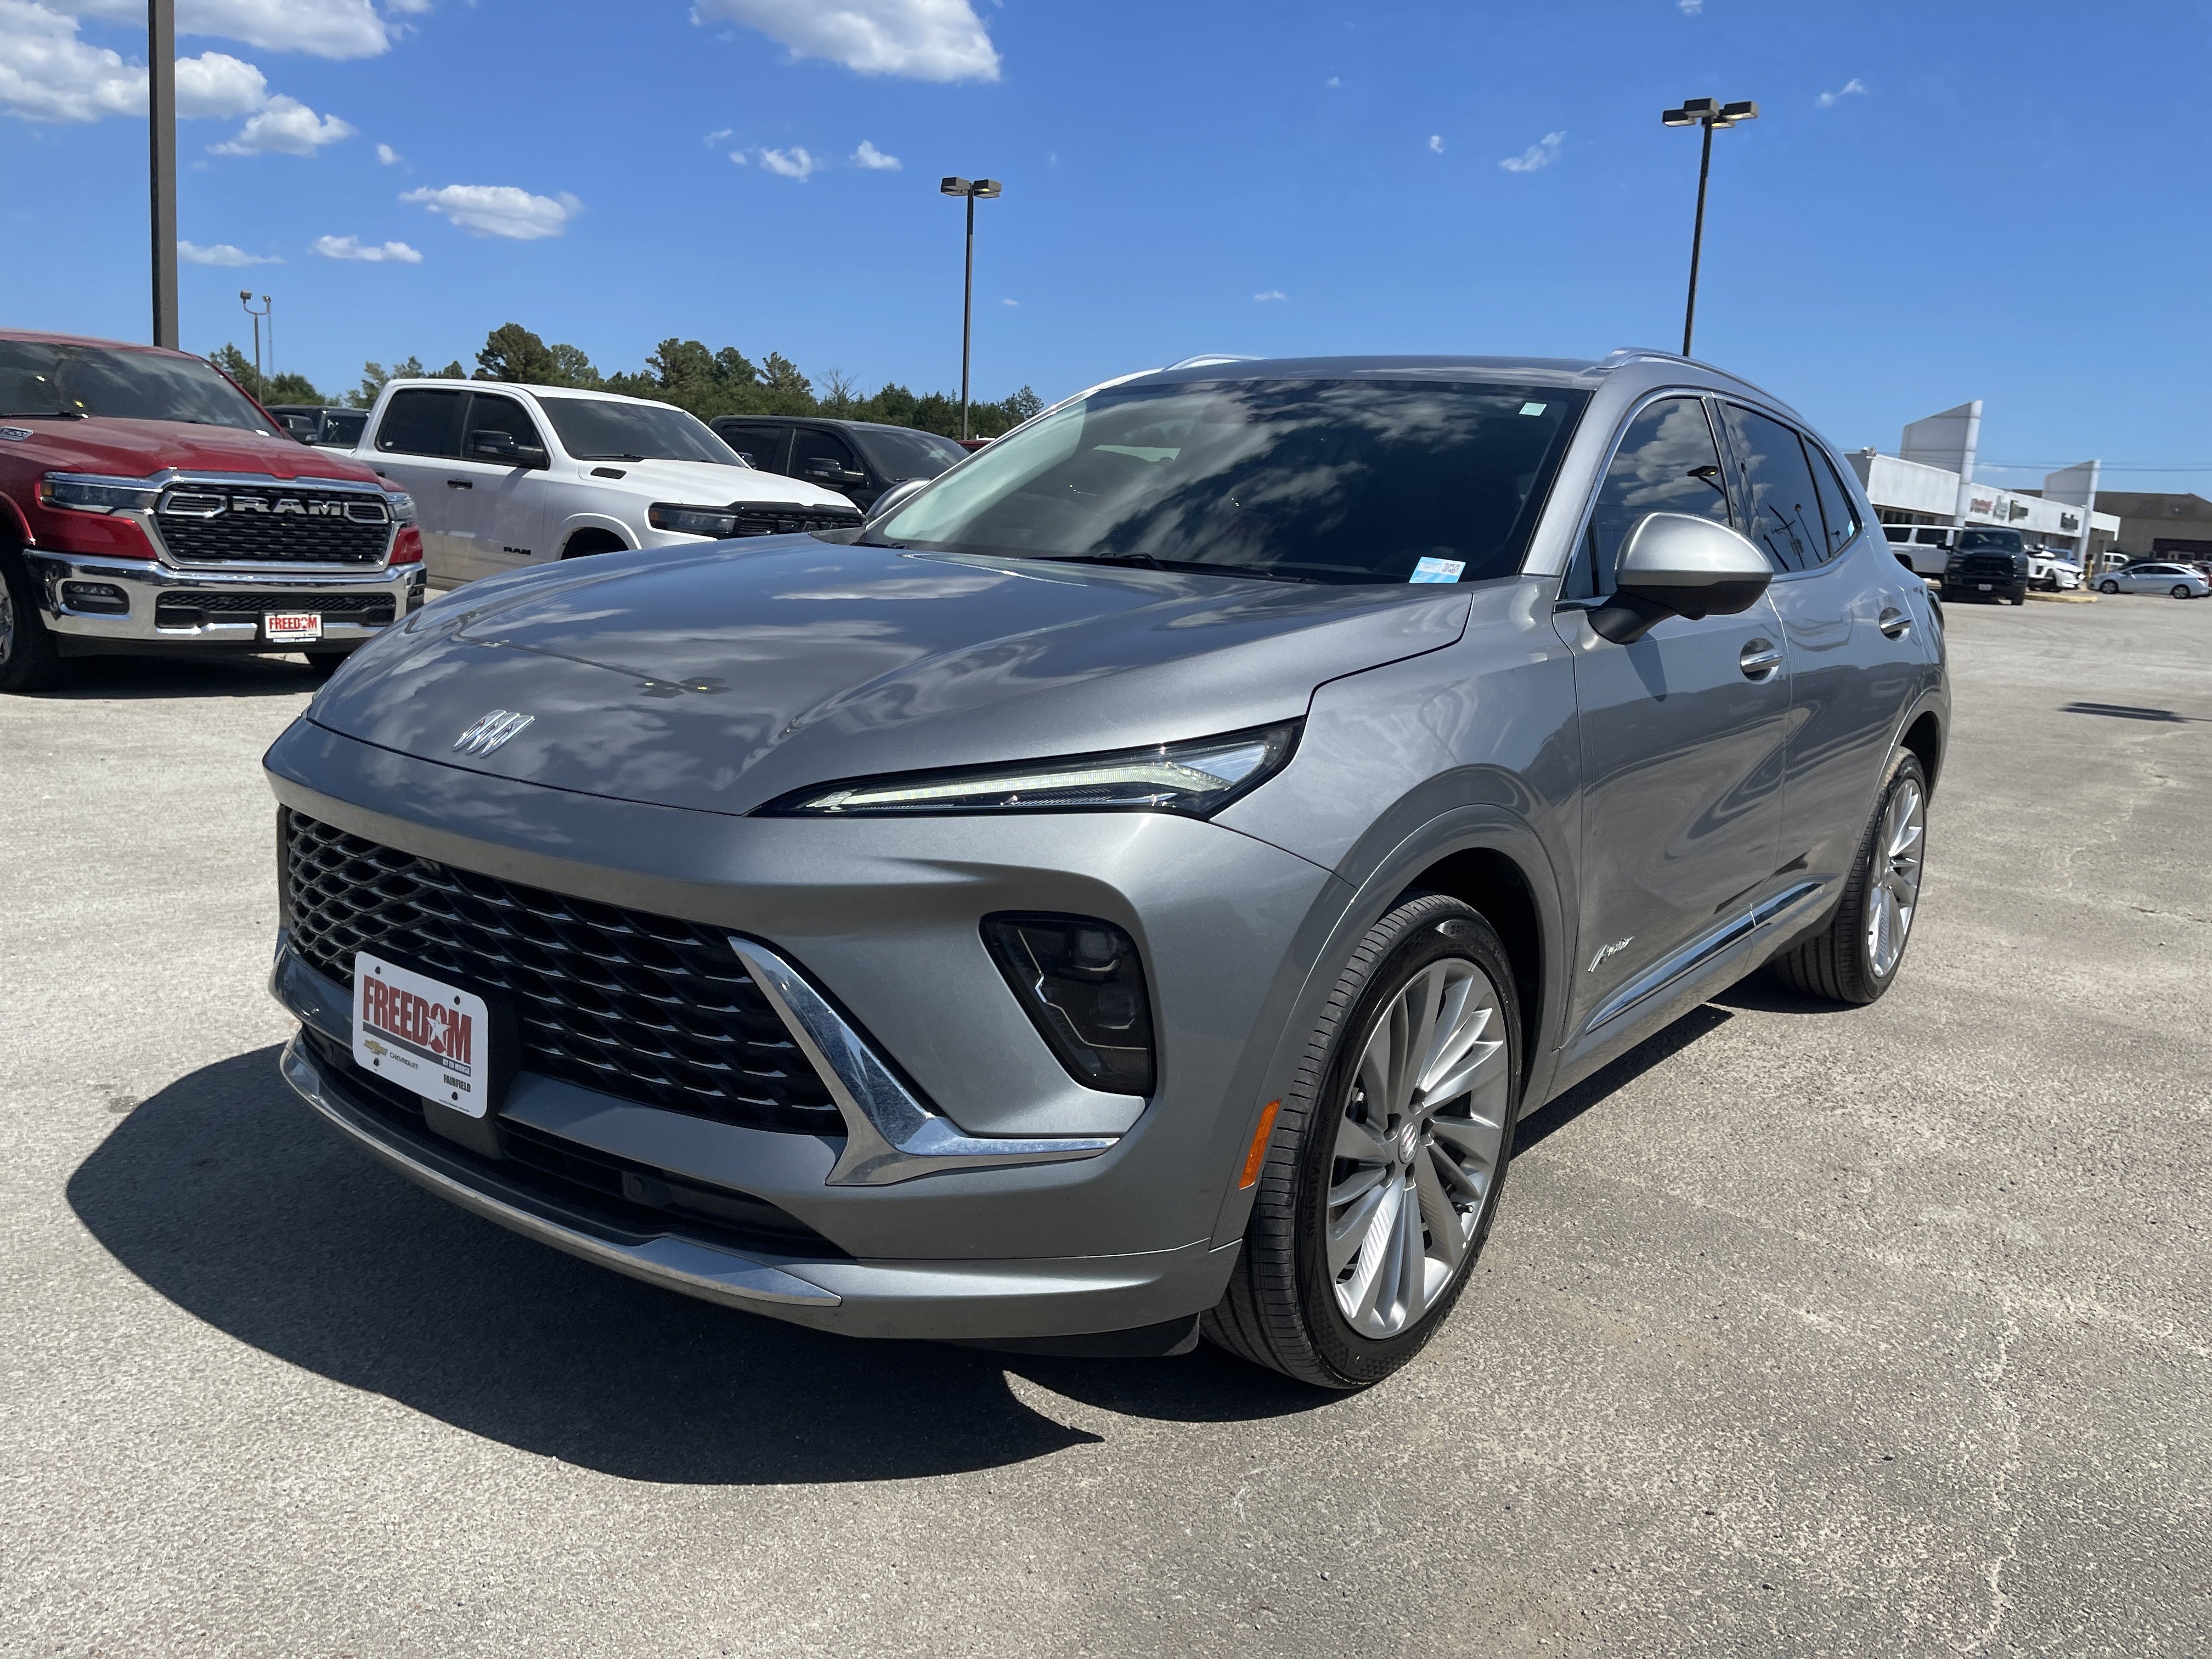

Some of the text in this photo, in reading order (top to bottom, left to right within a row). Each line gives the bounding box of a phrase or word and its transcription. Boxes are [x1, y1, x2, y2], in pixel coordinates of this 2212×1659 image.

[233, 495, 341, 516] RAM
[503, 546, 531, 555] RAM
[269, 617, 317, 629] FREEDOM
[363, 974, 472, 1065] FREEDOM
[390, 1052, 418, 1070] CHEVROLET
[443, 1074, 471, 1093] FAIRFIELD
